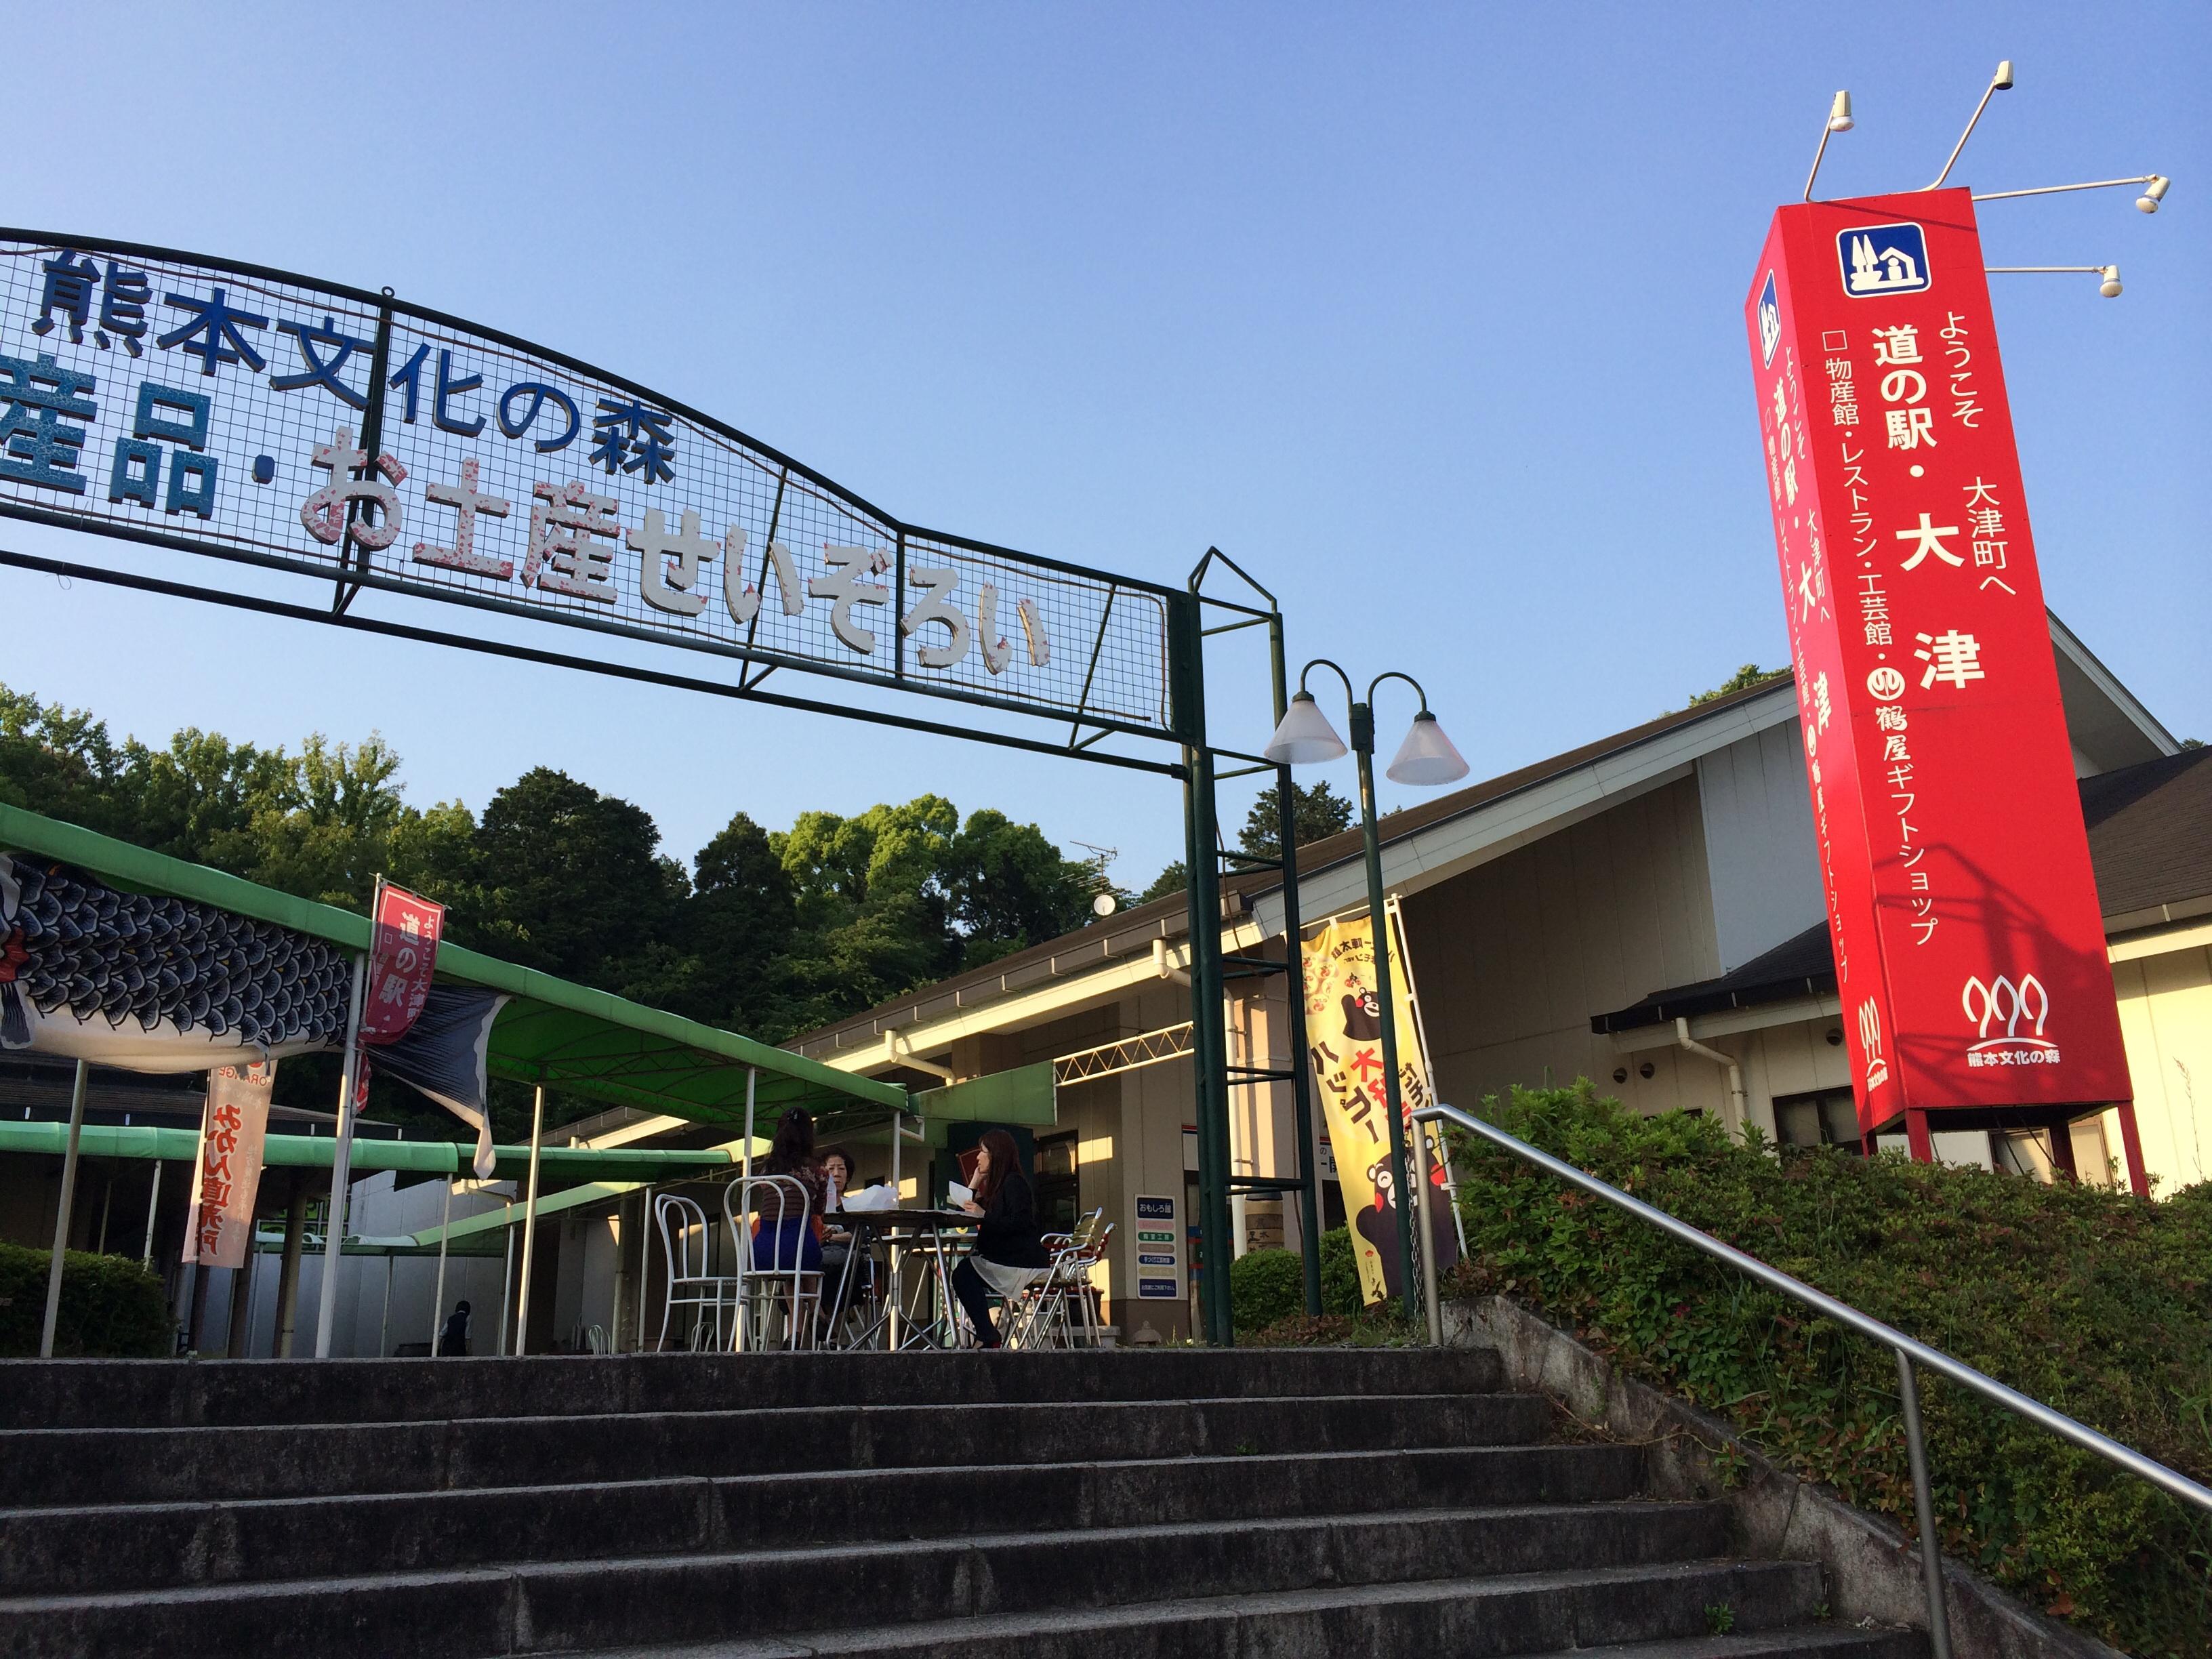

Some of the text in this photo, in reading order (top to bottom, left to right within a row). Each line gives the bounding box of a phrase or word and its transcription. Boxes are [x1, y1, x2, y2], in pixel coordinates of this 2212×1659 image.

[31, 248, 676, 485] 熊本文化の森
[1940, 311, 2016, 596] ようこそ 大津町へ
[1968, 1048, 2061, 1067] 熊本文化の森
